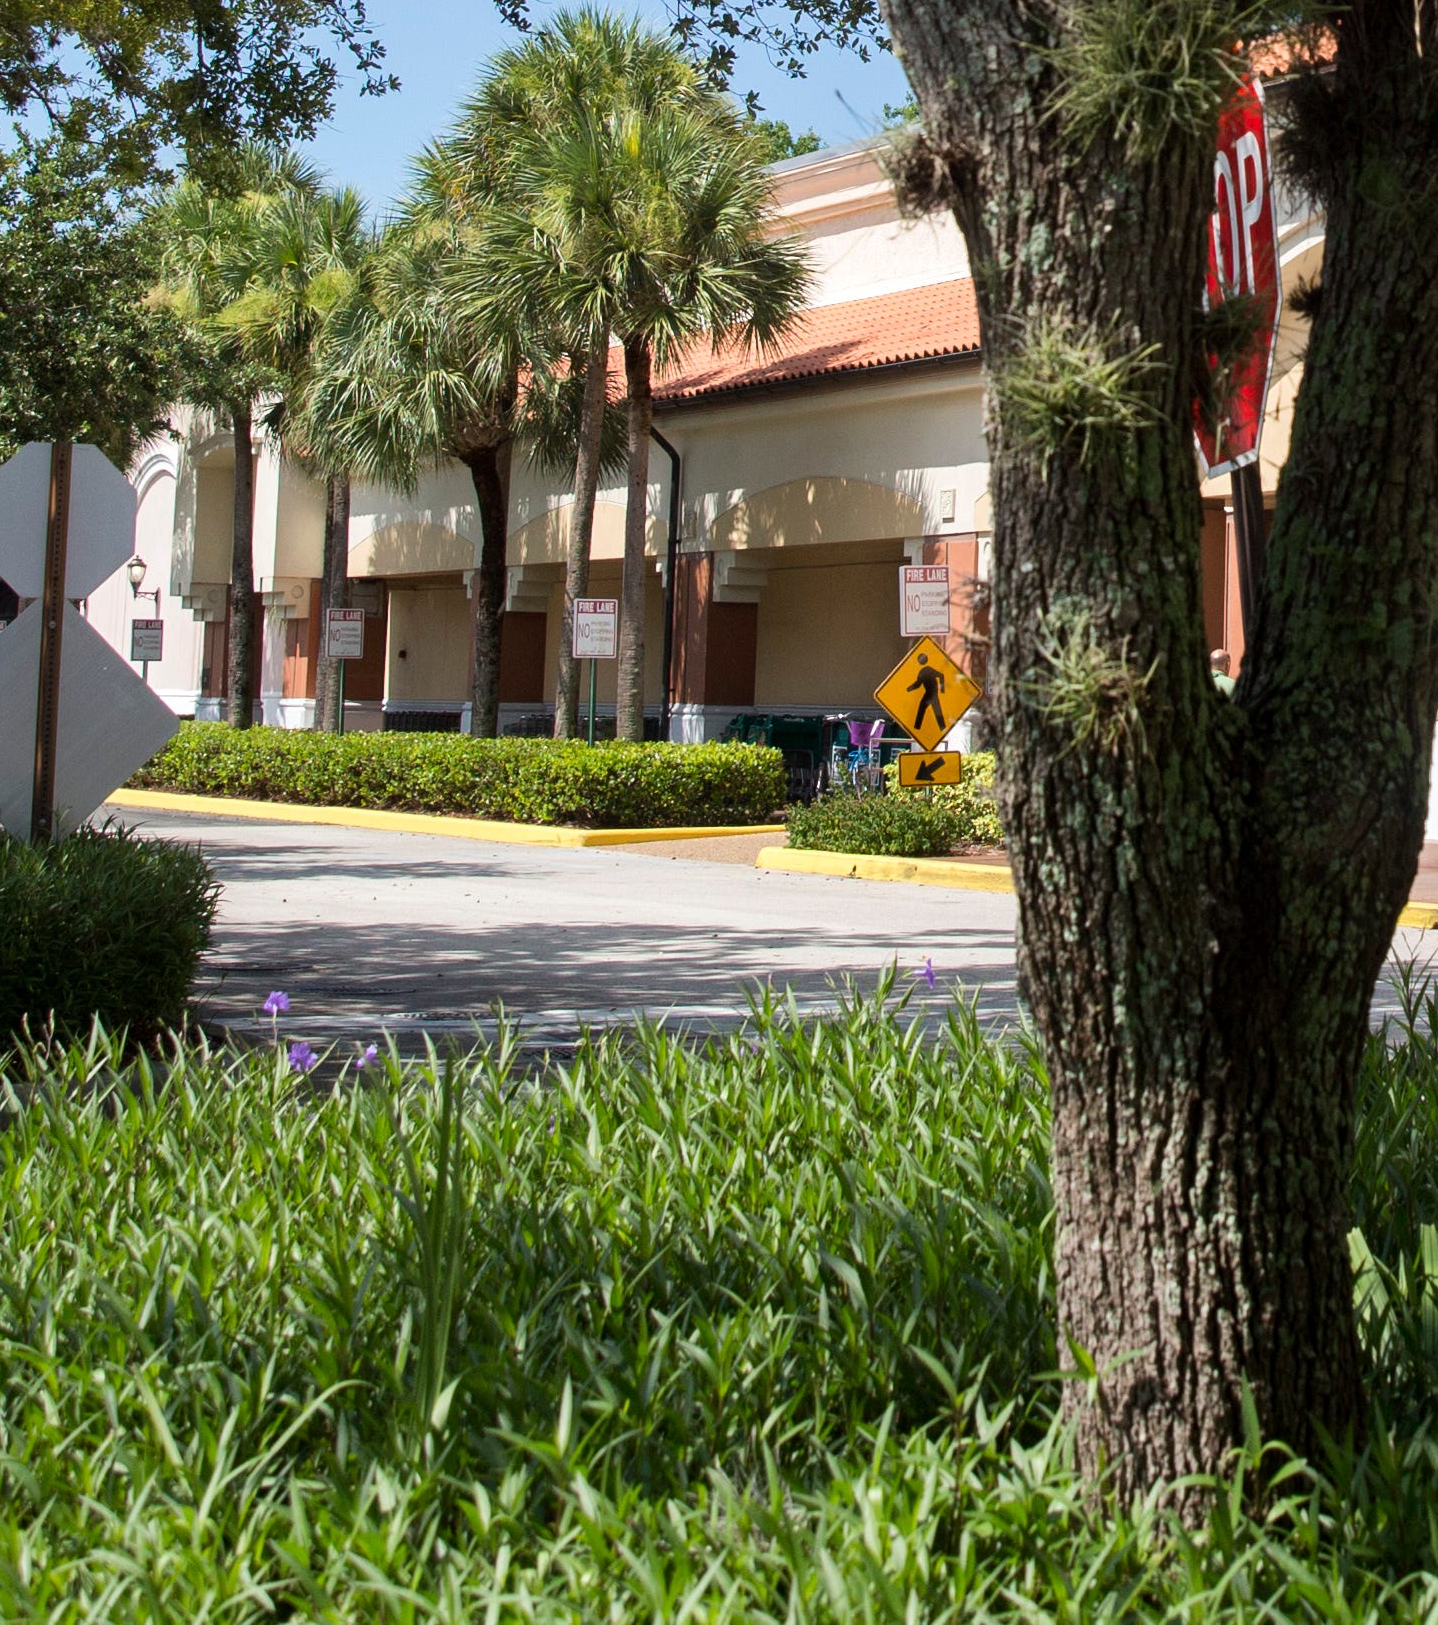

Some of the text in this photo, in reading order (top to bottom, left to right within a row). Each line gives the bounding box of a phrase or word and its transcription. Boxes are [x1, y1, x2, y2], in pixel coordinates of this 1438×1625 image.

[1213, 130, 1263, 300] OP
[906, 568, 947, 582] FIRE LANE
[578, 601, 615, 613] FIRE LANE
[907, 594, 921, 612] NO
[578, 623, 591, 639] NO
